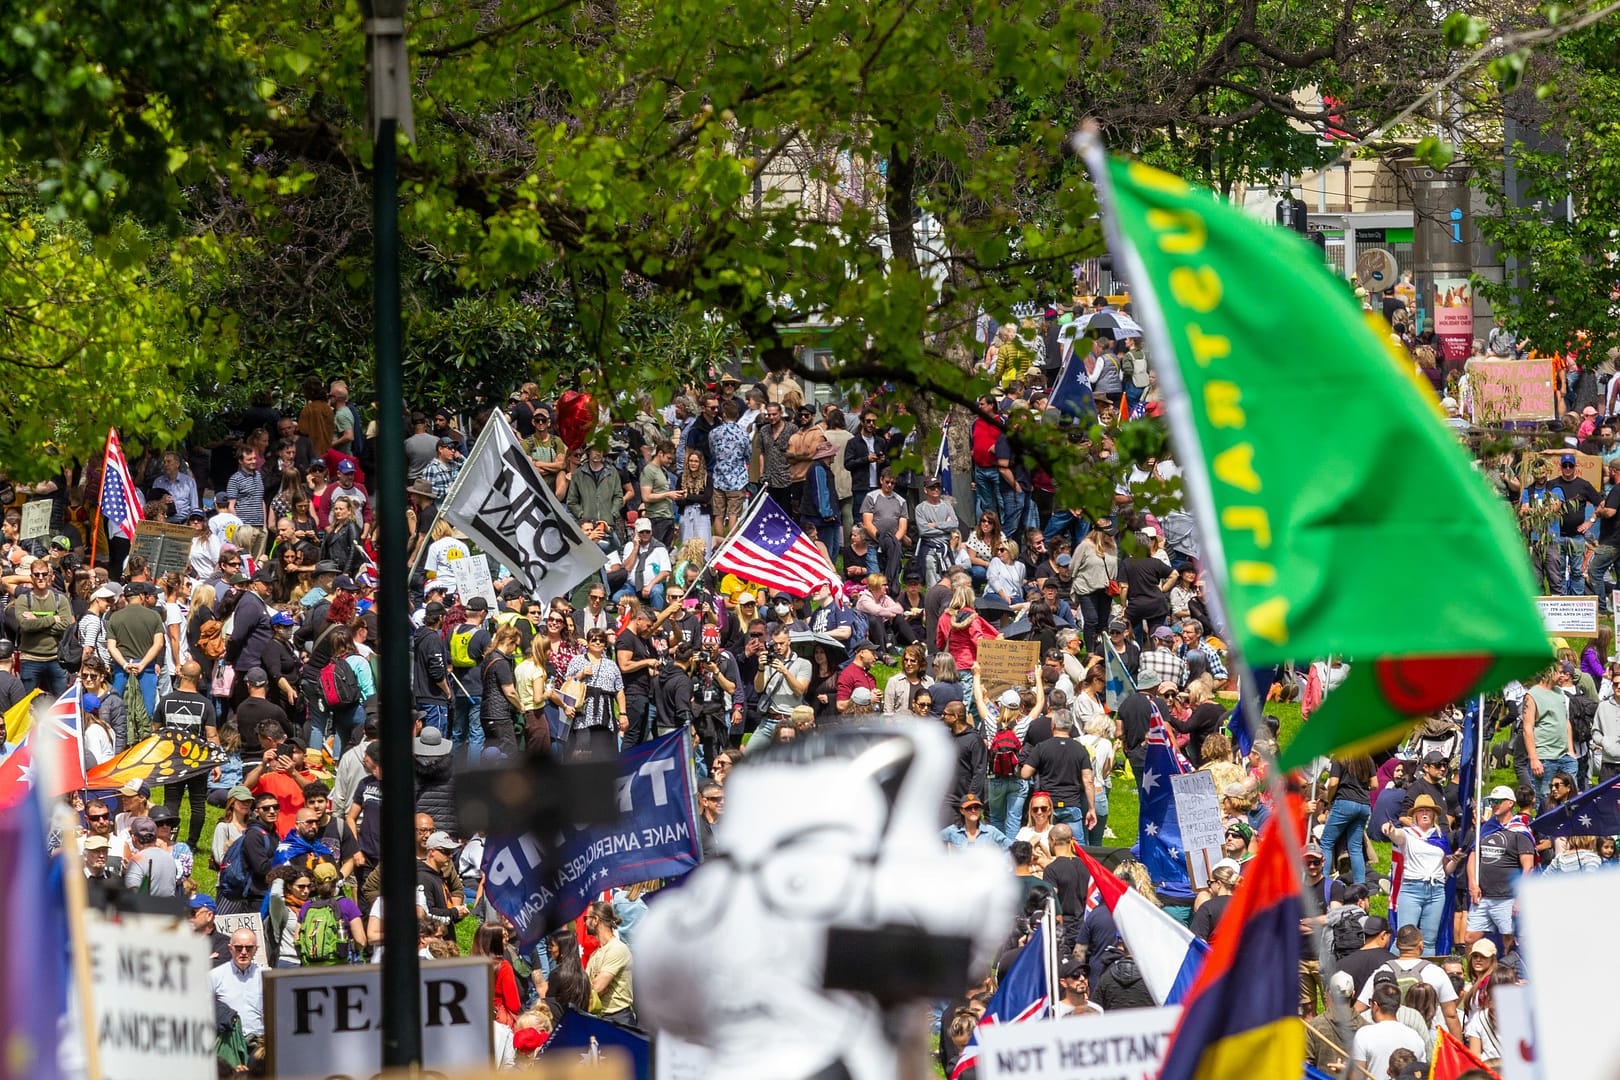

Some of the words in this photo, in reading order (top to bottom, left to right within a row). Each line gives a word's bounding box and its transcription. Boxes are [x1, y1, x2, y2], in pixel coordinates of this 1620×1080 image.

[1517, 362, 1551, 380] AWAY
[492, 464, 571, 563] NFO
[216, 917, 234, 934] WE
[237, 915, 257, 932] ARE
[116, 944, 192, 996] NEXT
[292, 978, 471, 1036] FER
[97, 1010, 217, 1058] ANDEMIC
[996, 1045, 1046, 1074] NOT
